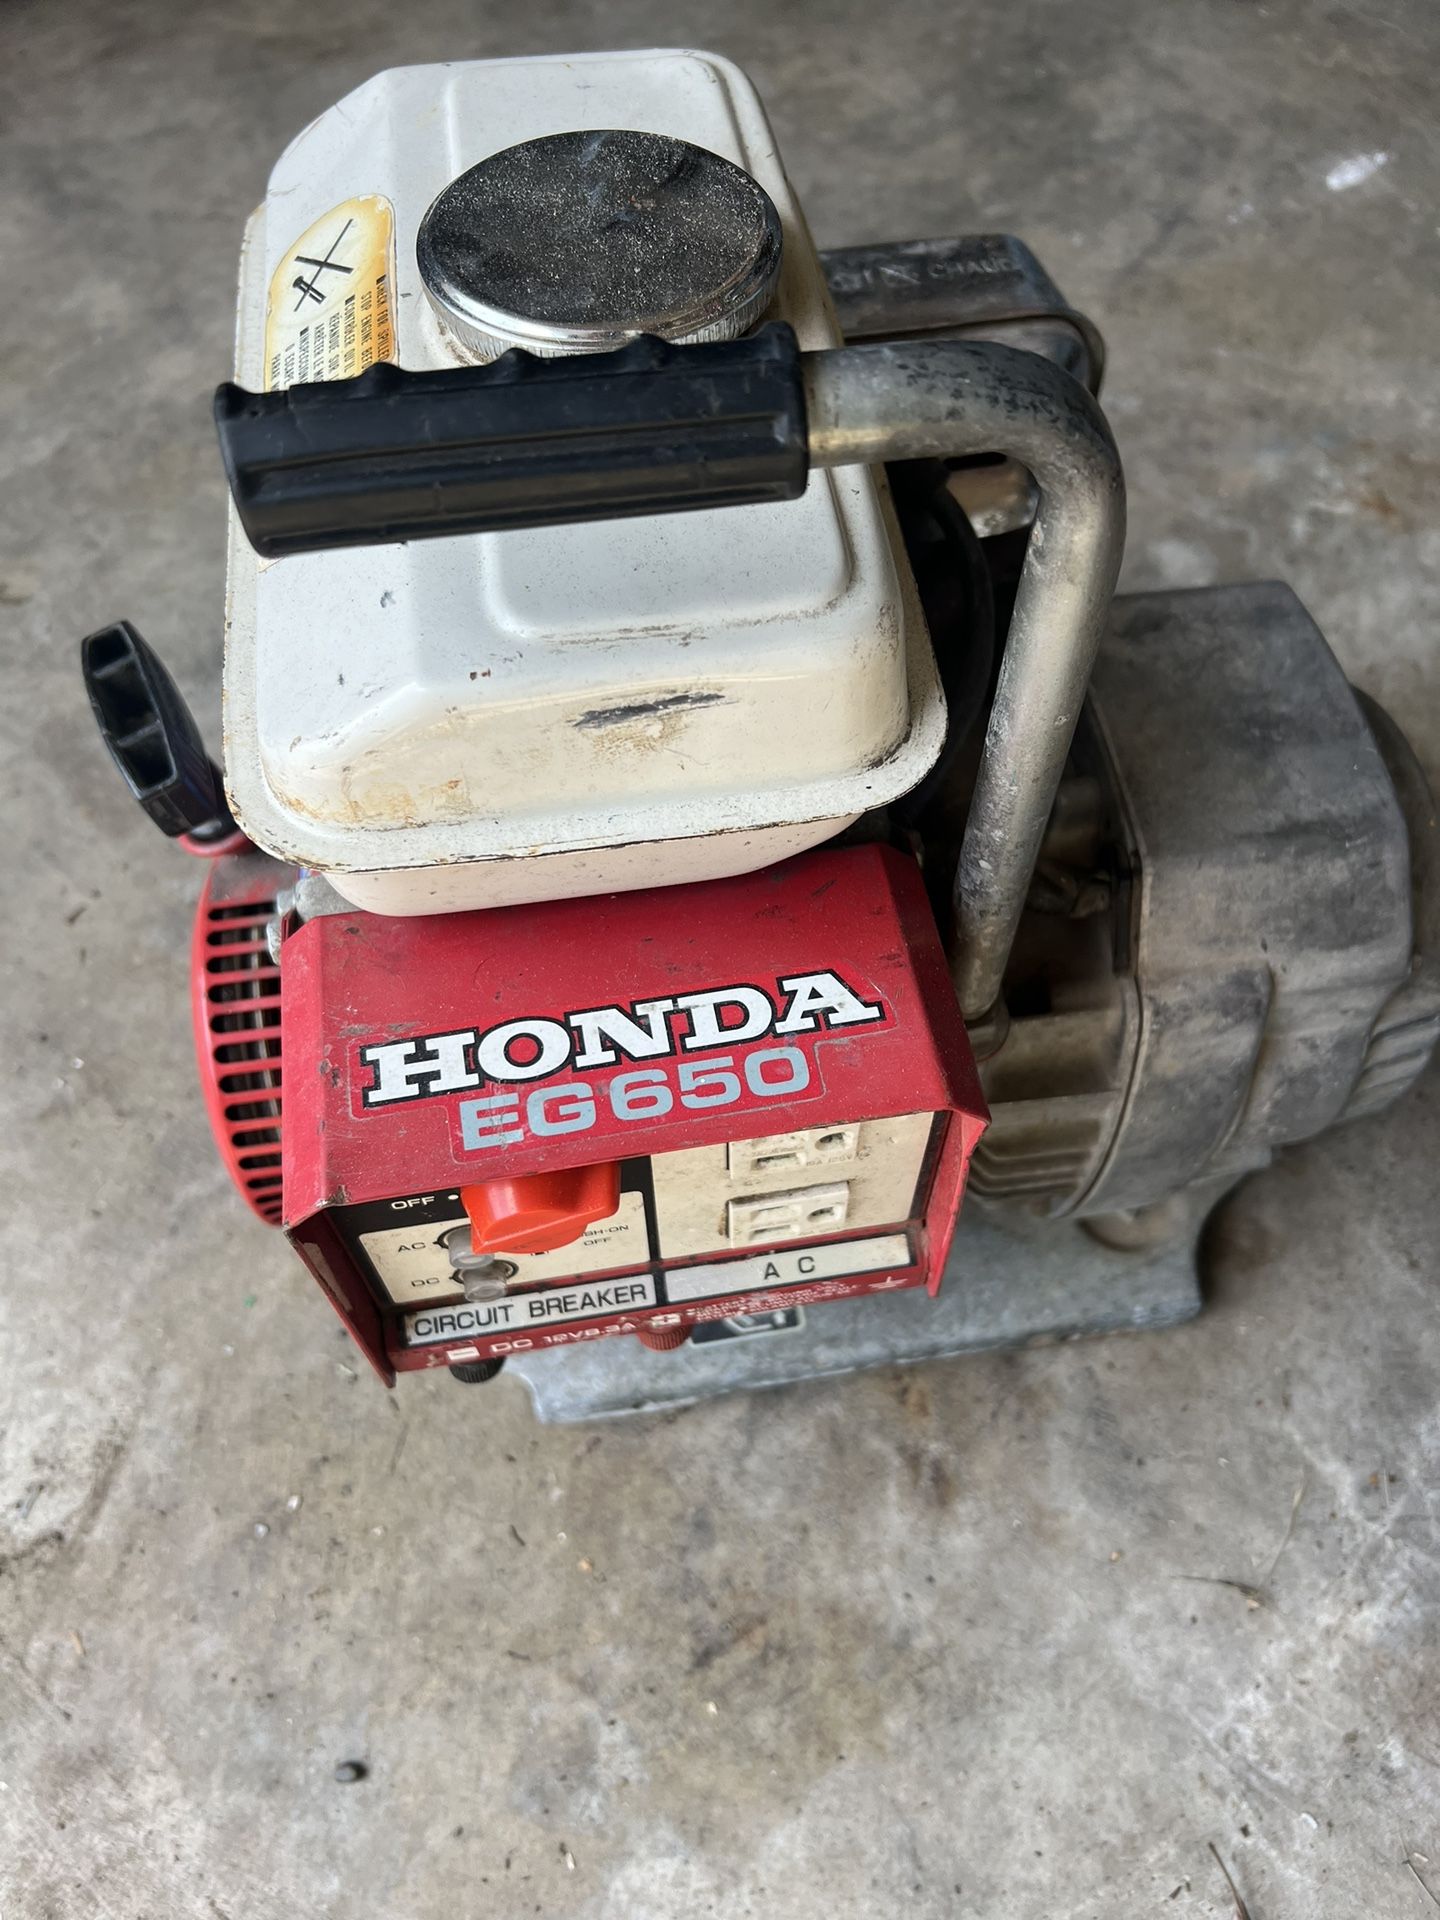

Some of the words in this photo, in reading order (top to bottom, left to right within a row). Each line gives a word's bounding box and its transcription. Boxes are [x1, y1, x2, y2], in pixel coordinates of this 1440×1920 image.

[361, 291, 372, 312] STOP
[377, 309, 389, 327] FOR
[361, 314, 372, 346] ENGINE
[361, 347, 372, 372] BEFO
[361, 969, 883, 1106] HONDA
[459, 1047, 810, 1151] EG650
[391, 1196, 436, 1210] OFF
[397, 1241, 427, 1254] AC
[410, 1276, 440, 1288] DC
[414, 1304, 514, 1336] CIRCUIT
[529, 1283, 647, 1318] BREAKER
[489, 1338, 535, 1354] DC
